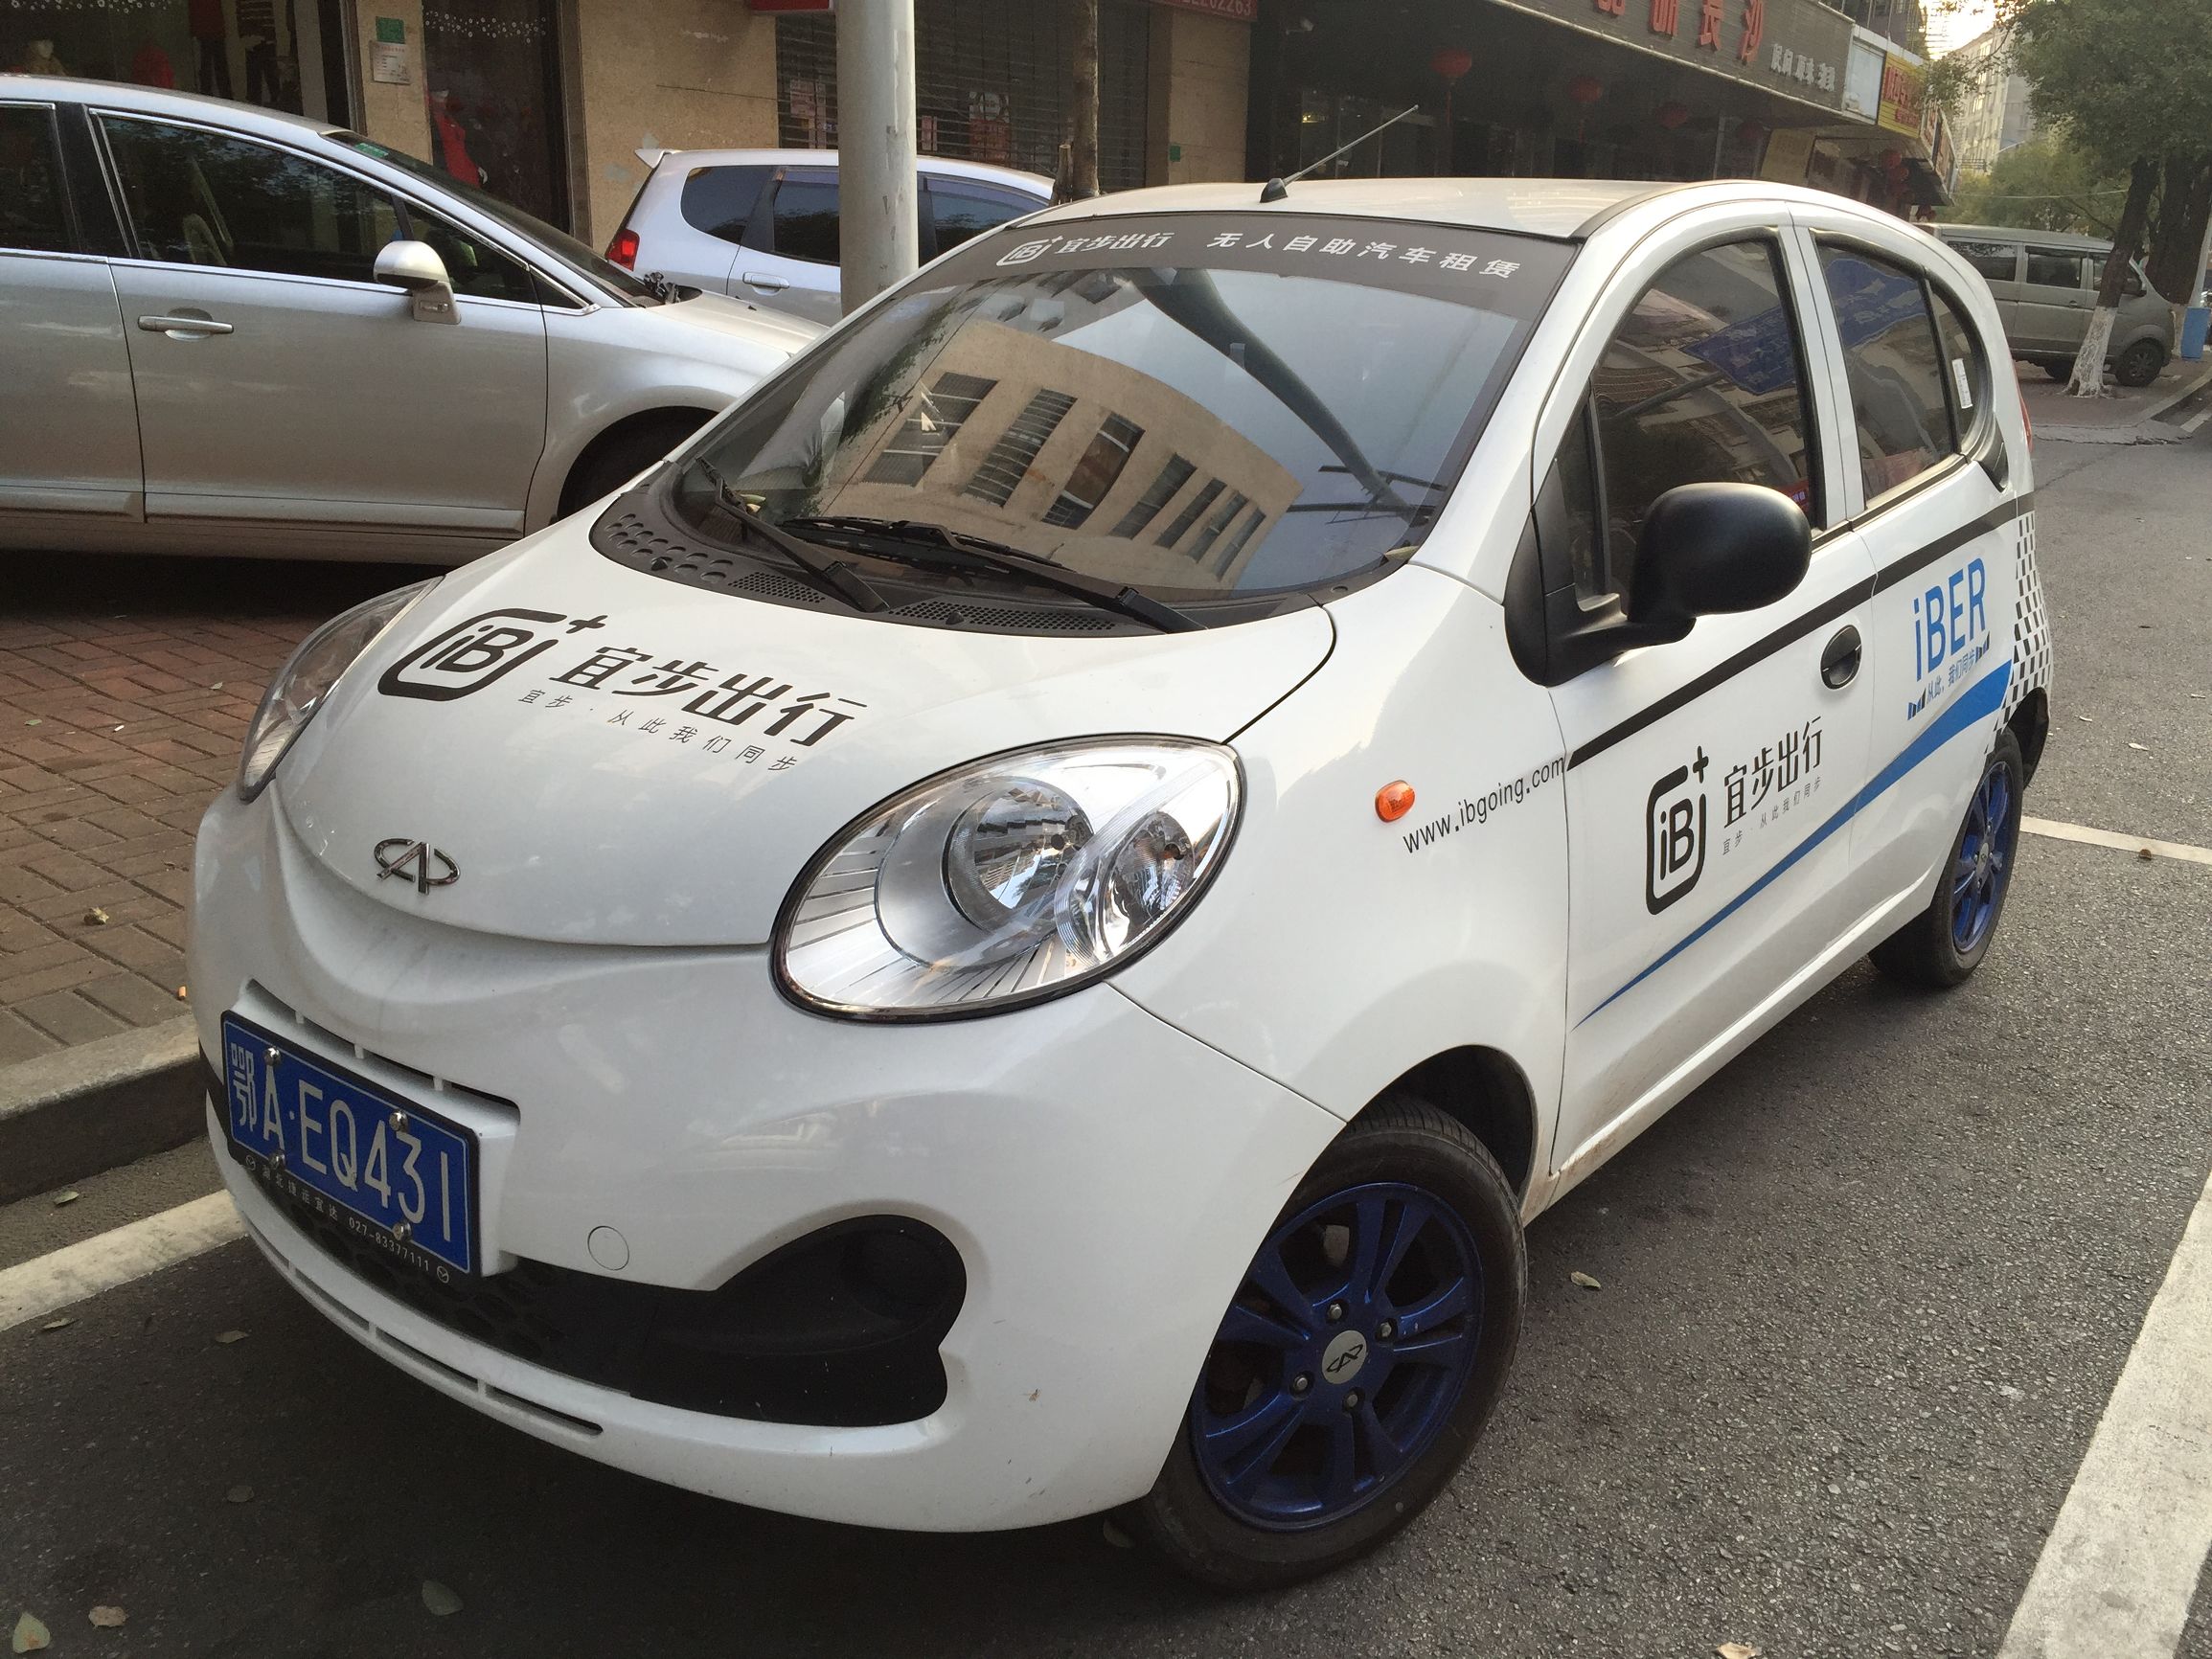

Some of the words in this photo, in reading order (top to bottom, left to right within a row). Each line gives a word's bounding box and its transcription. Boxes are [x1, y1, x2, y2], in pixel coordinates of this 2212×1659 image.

[1055, 232, 1175, 255] 宜步出行
[1206, 233, 1521, 279] 无人自助汽车租赁
[1913, 557, 1986, 682] iBER
[548, 646, 868, 747] 宜步出行
[1402, 756, 1565, 854] www.ibgoing.com
[1723, 716, 1823, 830] 宜步出行
[348, 1216, 430, 1272] 027-83377111
